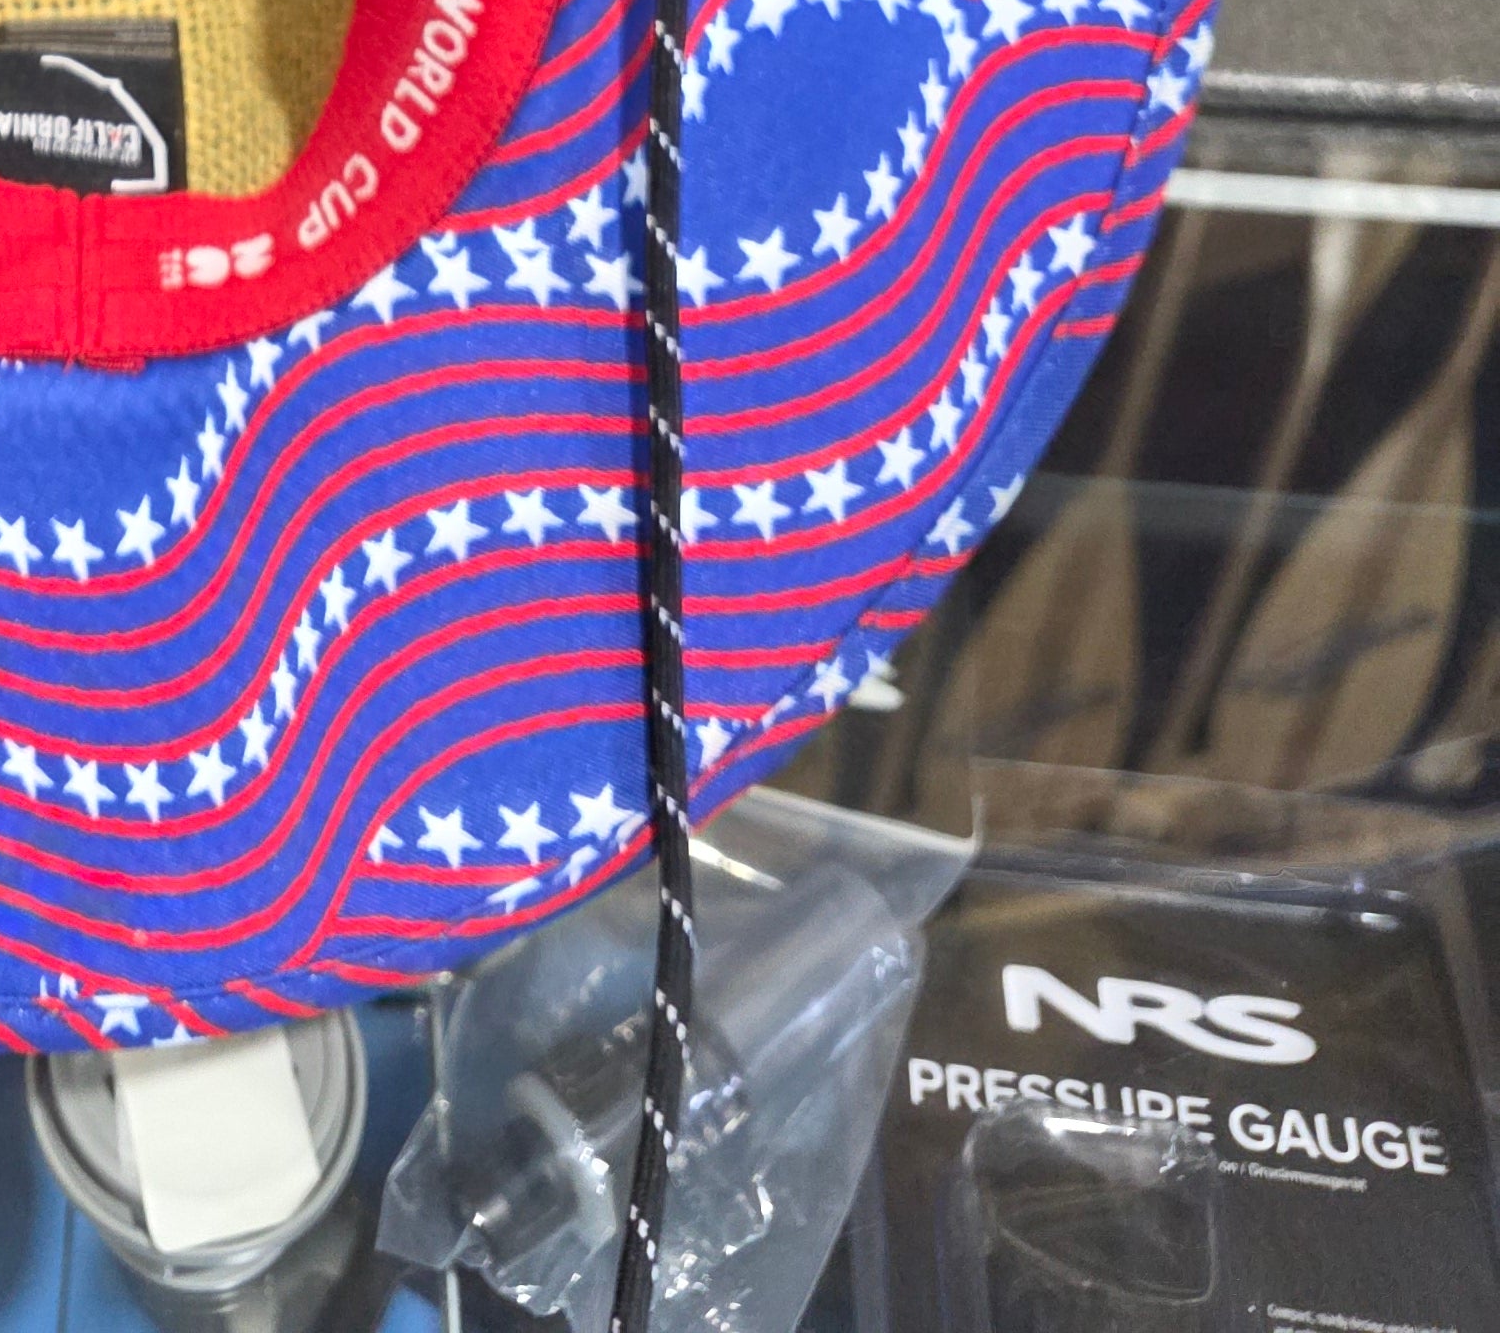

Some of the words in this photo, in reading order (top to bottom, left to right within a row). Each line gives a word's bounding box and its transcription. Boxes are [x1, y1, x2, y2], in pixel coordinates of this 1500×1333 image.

[297, 153, 379, 251] CUP
[1002, 964, 1317, 1065] NRS
[1228, 1102, 1450, 1176] GAUGE
